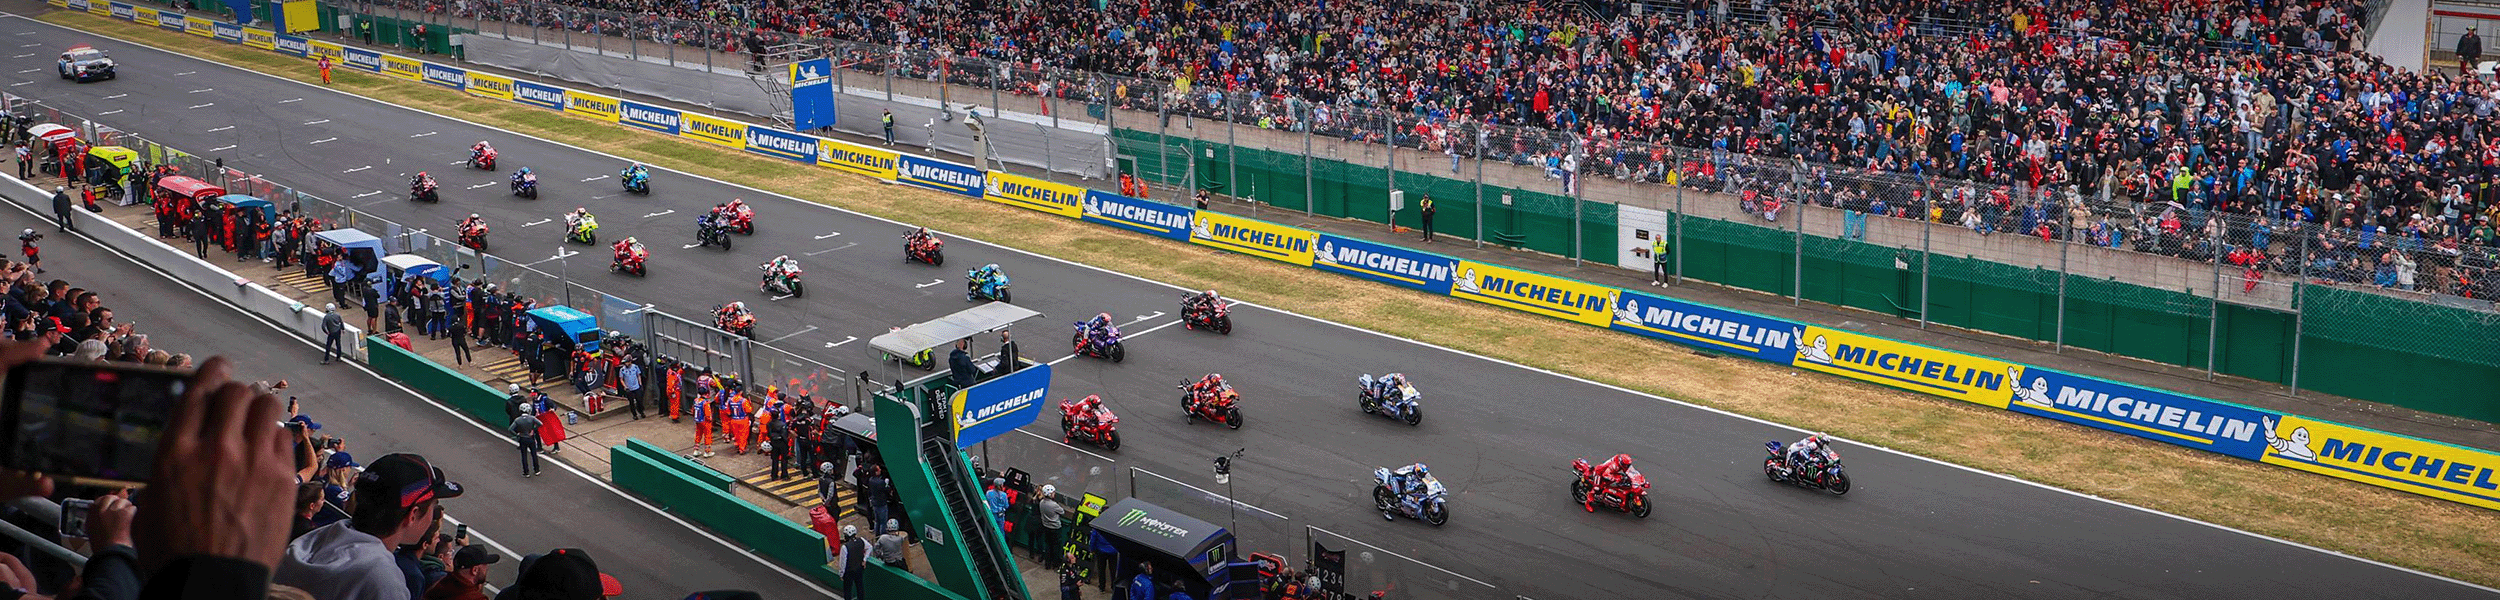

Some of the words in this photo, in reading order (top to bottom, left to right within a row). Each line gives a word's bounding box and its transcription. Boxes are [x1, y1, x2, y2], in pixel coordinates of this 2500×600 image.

[279, 38, 306, 51] MICHELIN
[349, 52, 379, 66] MICHELIN
[388, 60, 420, 74] MICHELIN
[429, 68, 463, 84] MICHELIN
[474, 78, 511, 93] MICHELIN
[794, 77, 829, 89] MICHELIN
[521, 86, 562, 104] MICHELIN
[574, 97, 617, 114] MICHELIN
[629, 106, 678, 127] MICHELIN
[691, 120, 742, 140] MICHELIN
[758, 133, 815, 156] MICHELIN
[832, 148, 893, 171] MICHELIN
[912, 164, 981, 189] MICHELIN
[1002, 181, 1078, 207] MICHELIN
[1101, 200, 1188, 230] MICHELIN
[1213, 223, 1309, 254] MICHELIN
[1337, 246, 1449, 281] MICHELIN
[1481, 275, 1607, 313] MICHELIN
[1644, 305, 1791, 350] MICHELIN
[1835, 343, 2004, 391] MICHELIN
[935, 389, 945, 420] DELAYED
[977, 388, 1044, 419] MICHELIN
[2056, 385, 2257, 442] MICHELIN
